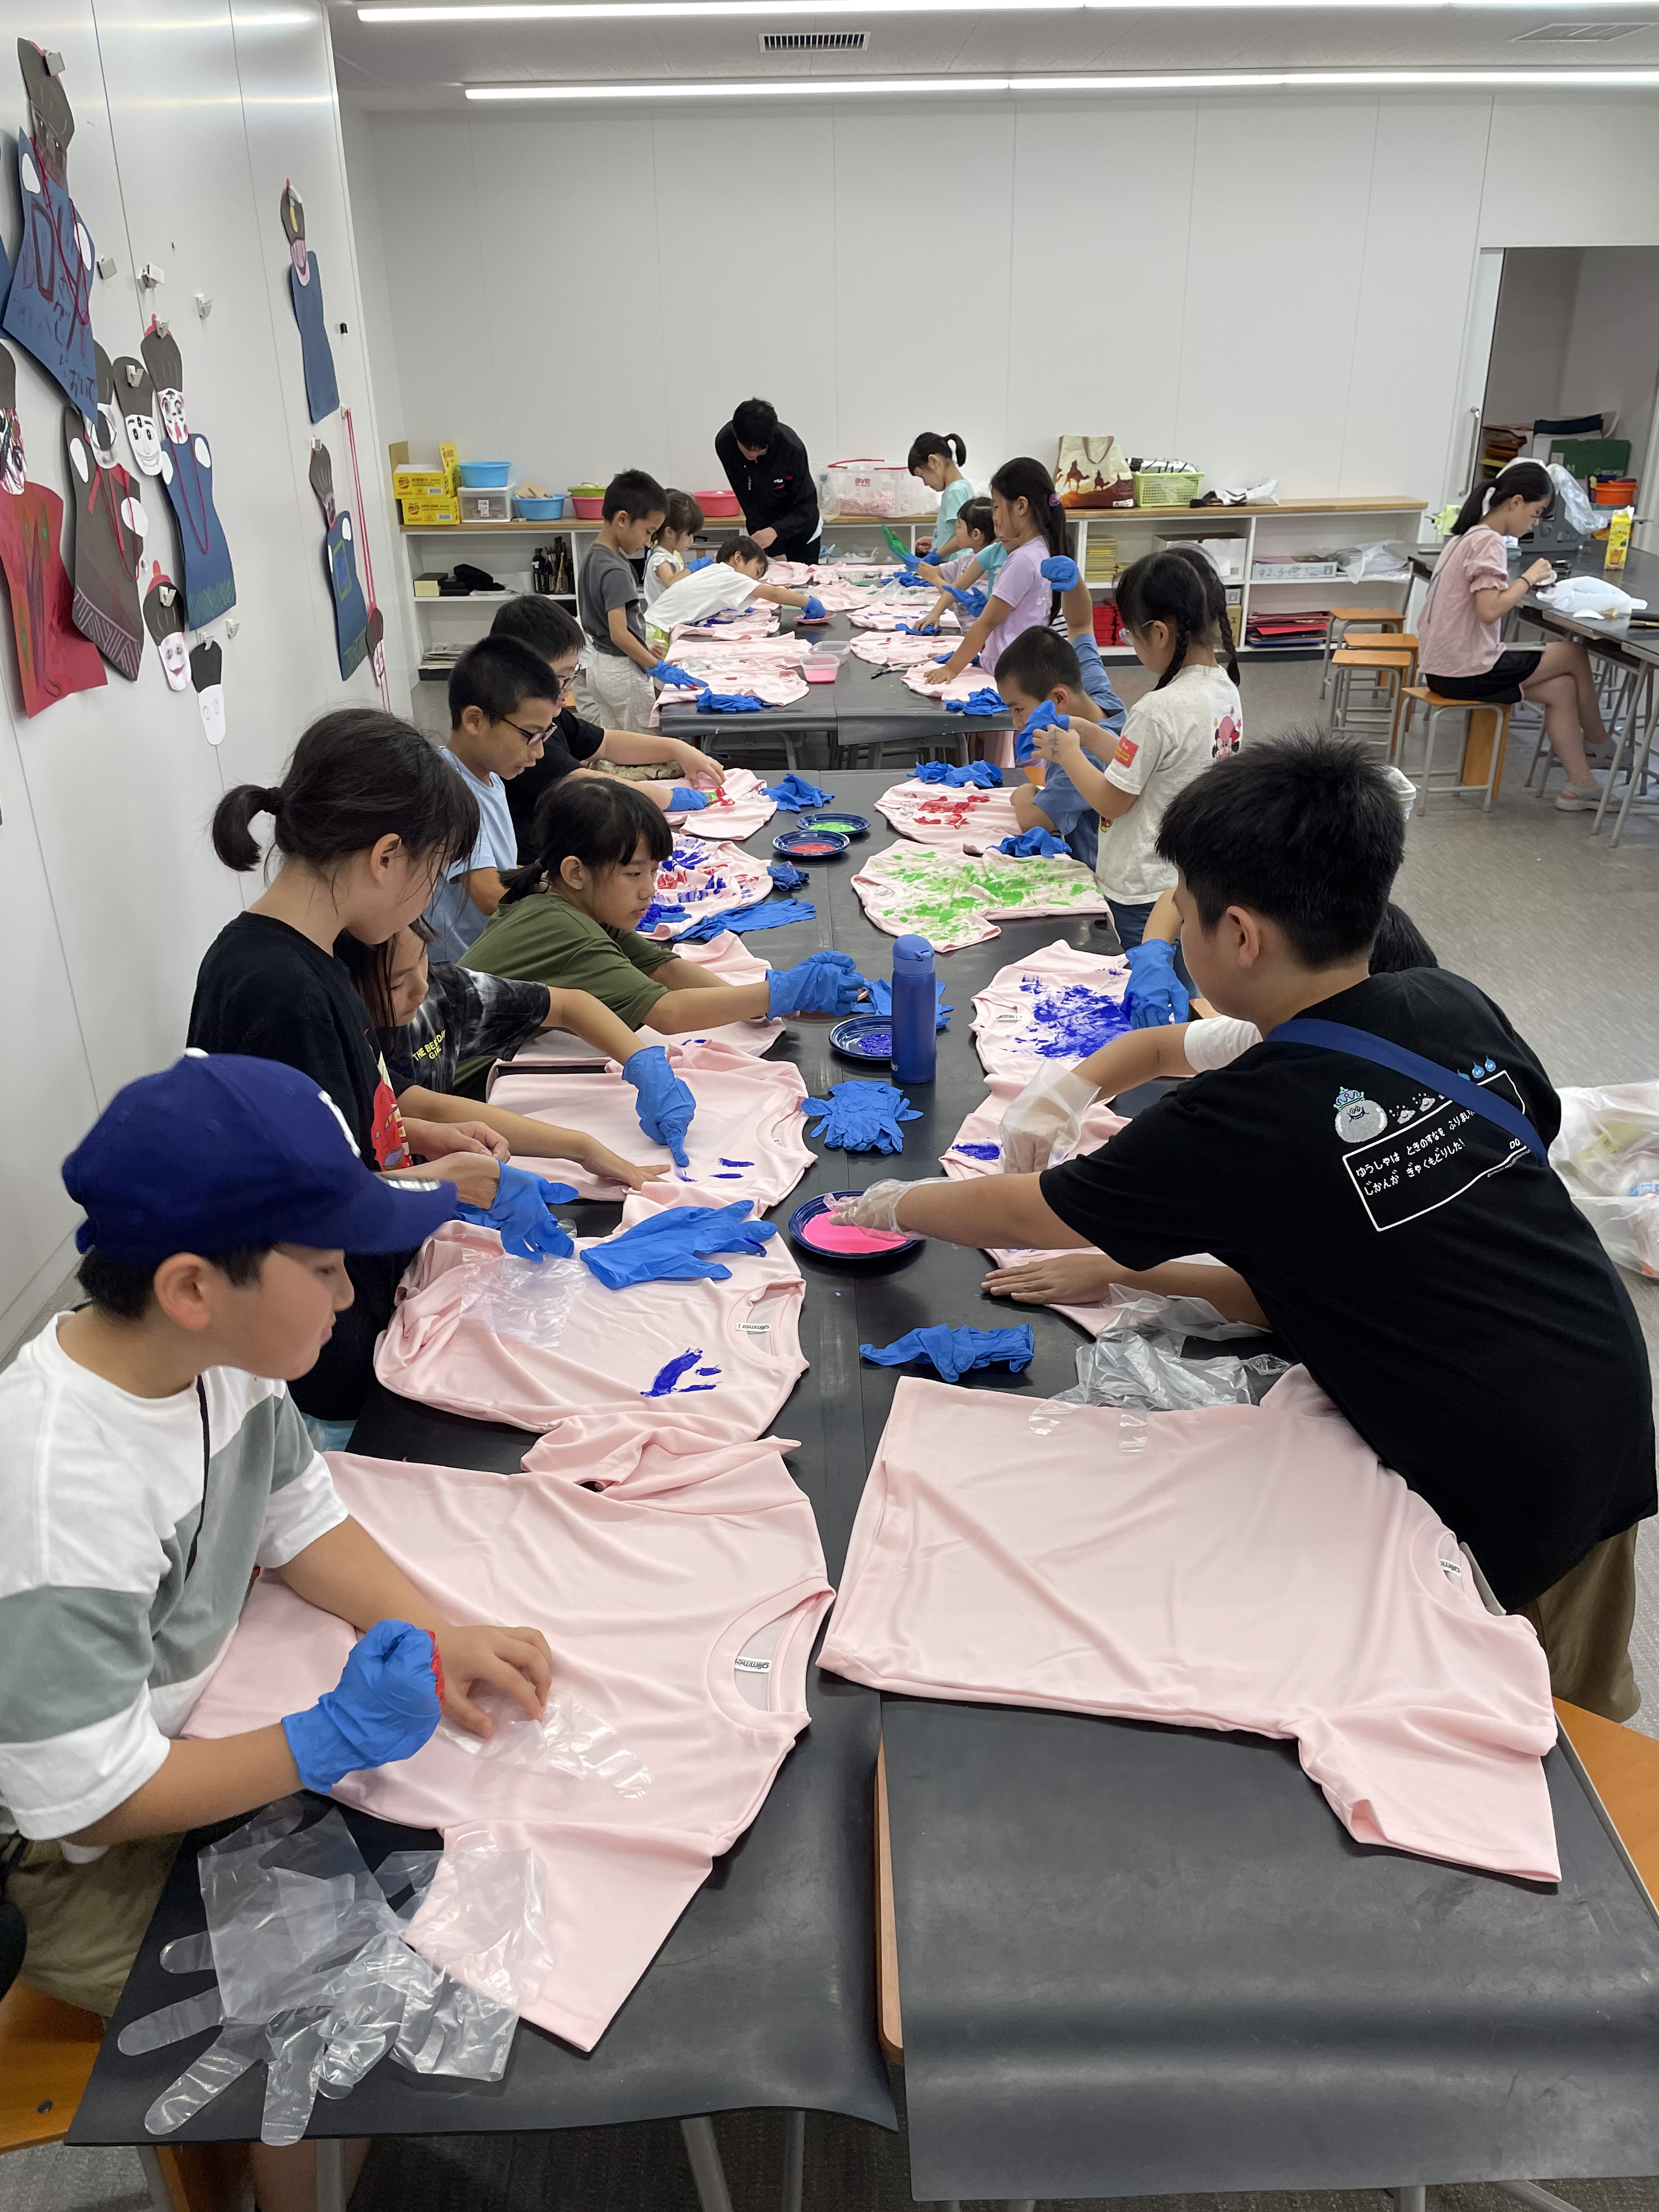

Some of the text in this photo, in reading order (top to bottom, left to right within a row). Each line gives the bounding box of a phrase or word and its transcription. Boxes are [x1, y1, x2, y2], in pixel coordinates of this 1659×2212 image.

[412, 1047, 427, 1061] THE
[1406, 1127, 1446, 1155] ときのすなを
[1364, 1169, 1400, 1195] じかんが
